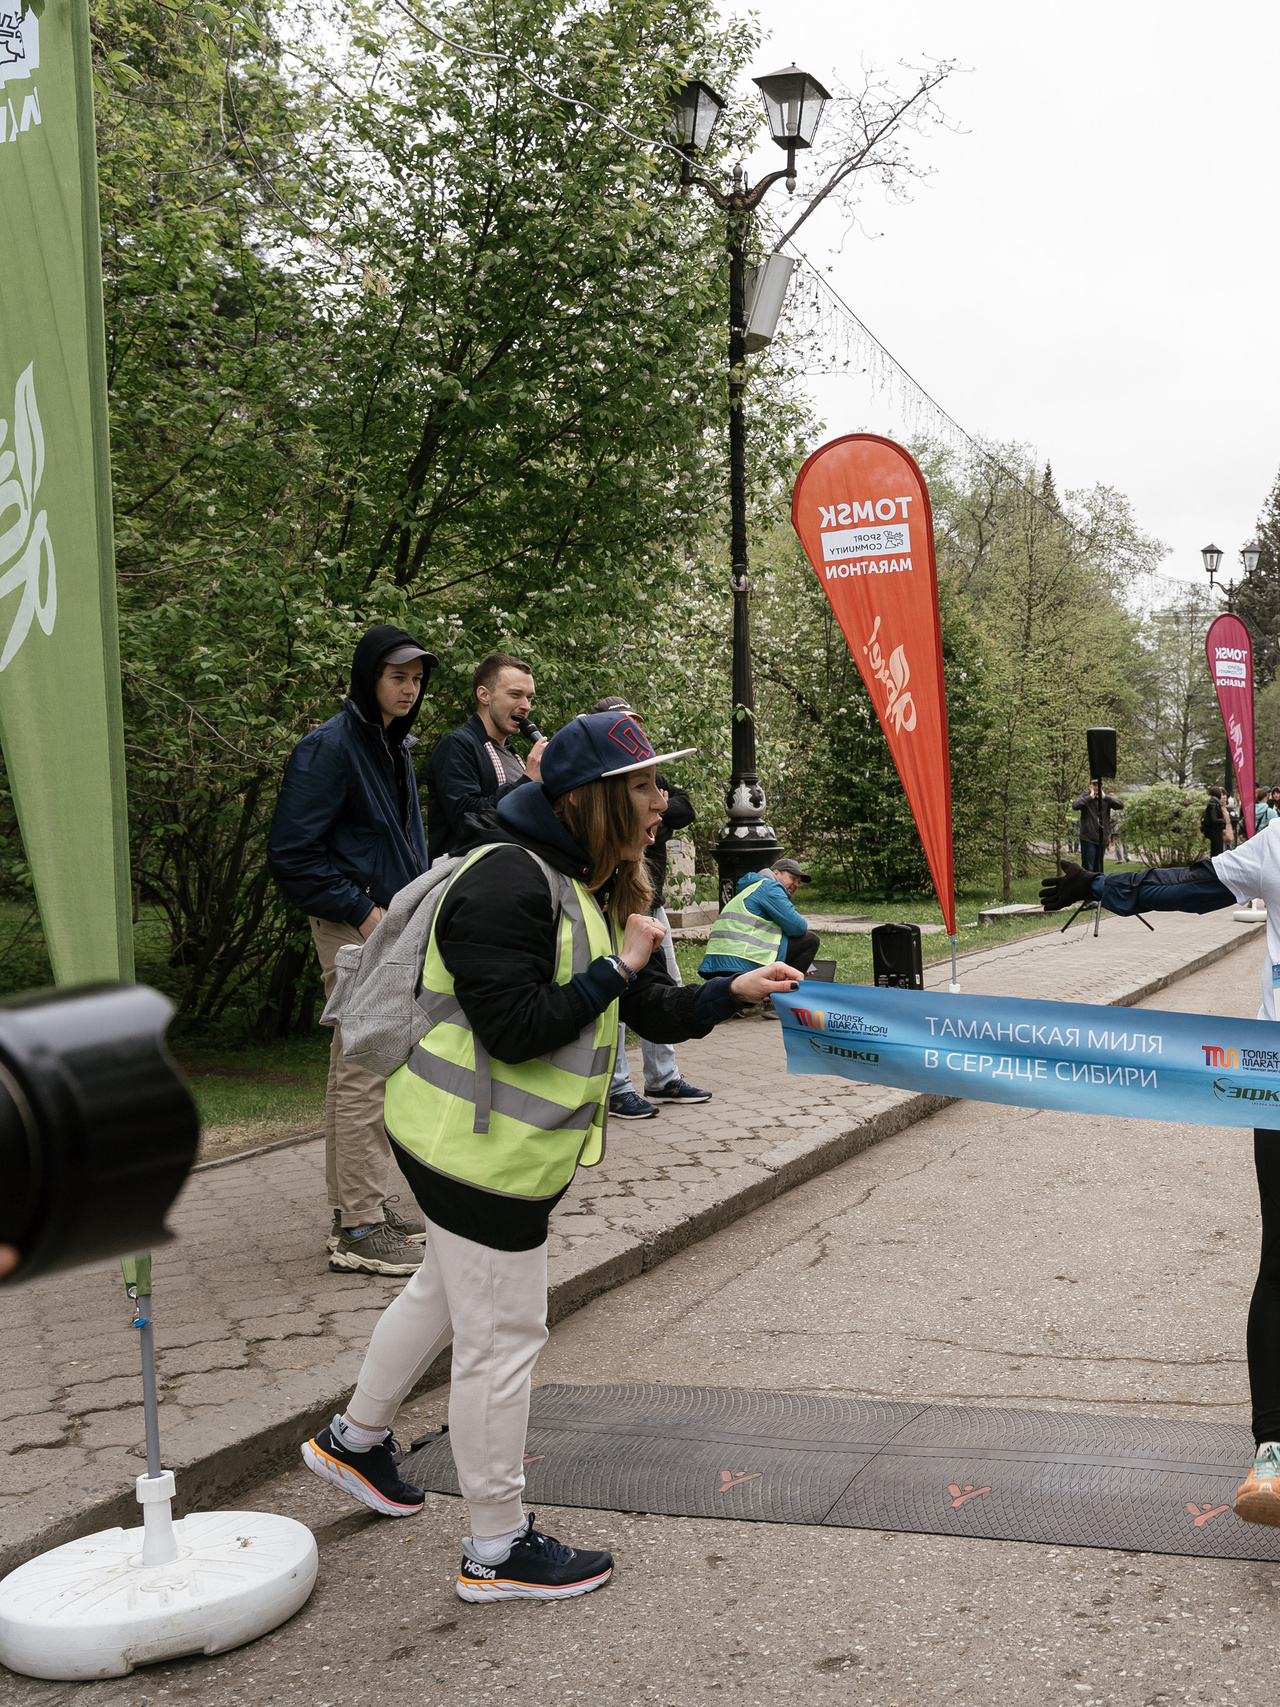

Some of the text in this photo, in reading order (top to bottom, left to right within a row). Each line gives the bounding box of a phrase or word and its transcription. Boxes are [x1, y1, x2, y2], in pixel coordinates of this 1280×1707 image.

[827, 1012, 864, 1024] TOMSK
[828, 1020, 888, 1035] MARATHON
[925, 1016, 1163, 1055] ТАМАНСКАЯ МИЛЯ
[821, 1043, 880, 1063] ЭФКО
[1240, 1049, 1279, 1060] TOMSK
[924, 1049, 1158, 1089] В СЕРДЦЕ СИБИРИ
[464, 1560, 496, 1580] HOKA
